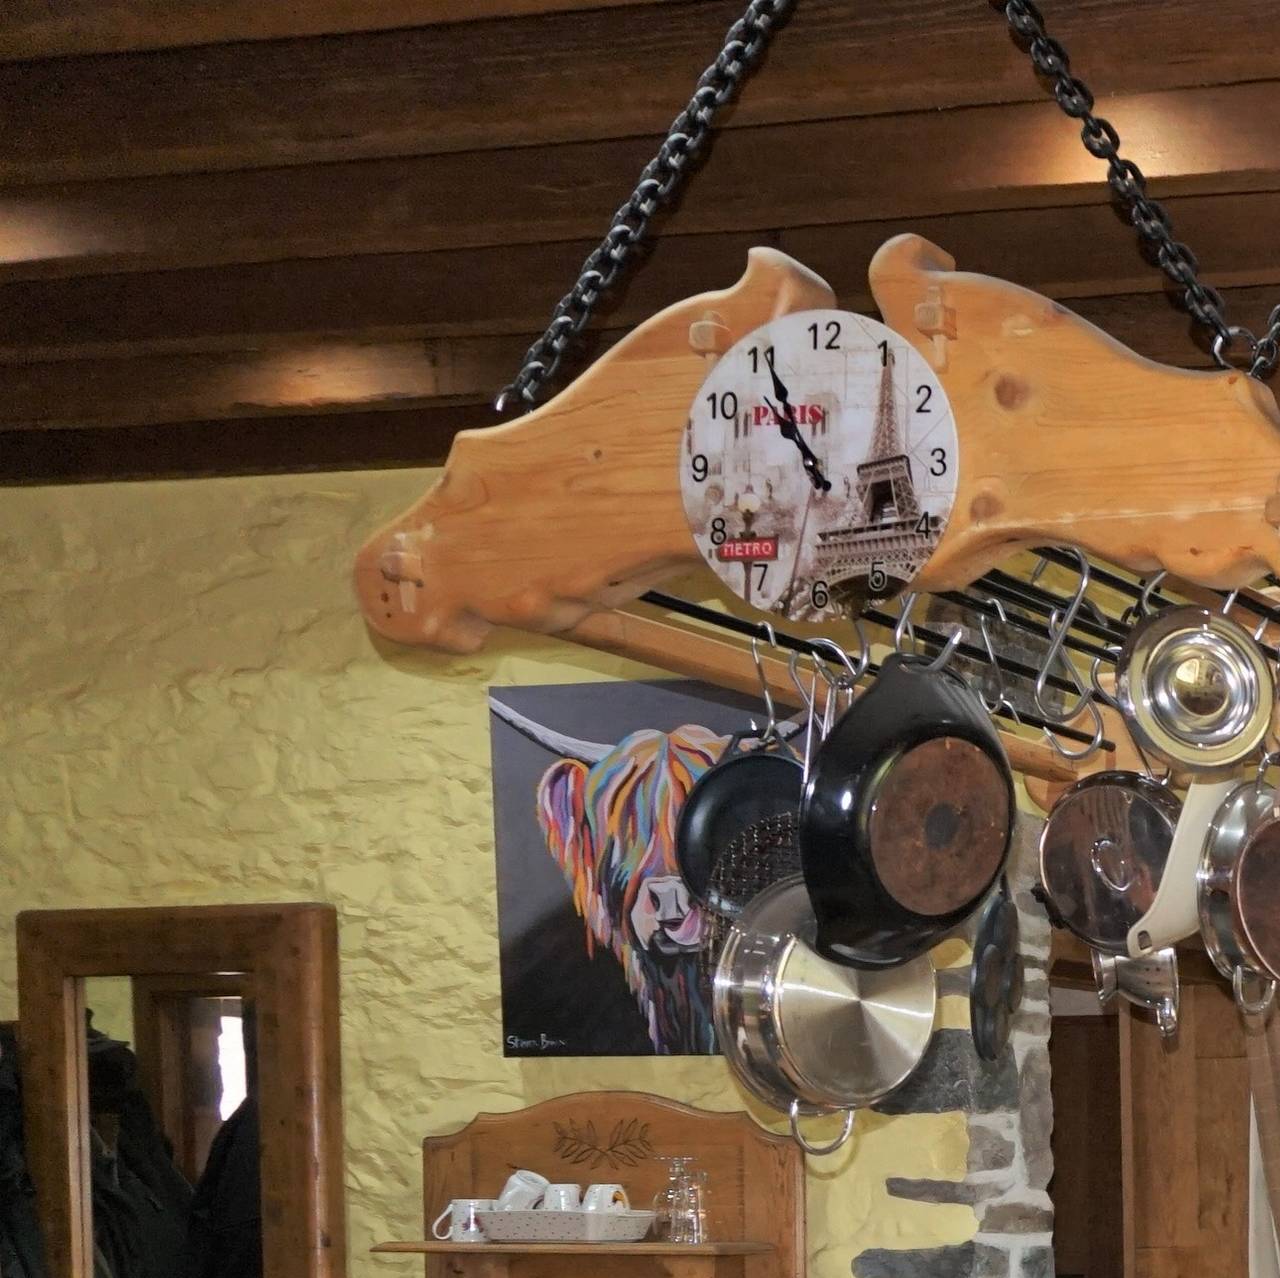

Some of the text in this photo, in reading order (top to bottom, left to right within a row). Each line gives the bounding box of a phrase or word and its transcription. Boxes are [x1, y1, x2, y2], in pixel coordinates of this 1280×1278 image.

[807, 321, 841, 350] 12
[748, 346, 775, 373] 11
[877, 340, 888, 367] 1
[706, 391, 738, 420] 10
[915, 385, 932, 413] 2
[691, 454, 709, 483] 9
[929, 447, 947, 476] 3
[710, 517, 727, 546] 8
[915, 511, 932, 539] 4
[723, 542, 773, 557] METRO
[752, 563, 768, 591] 7
[868, 562, 886, 591] 5
[811, 580, 829, 609] 6
